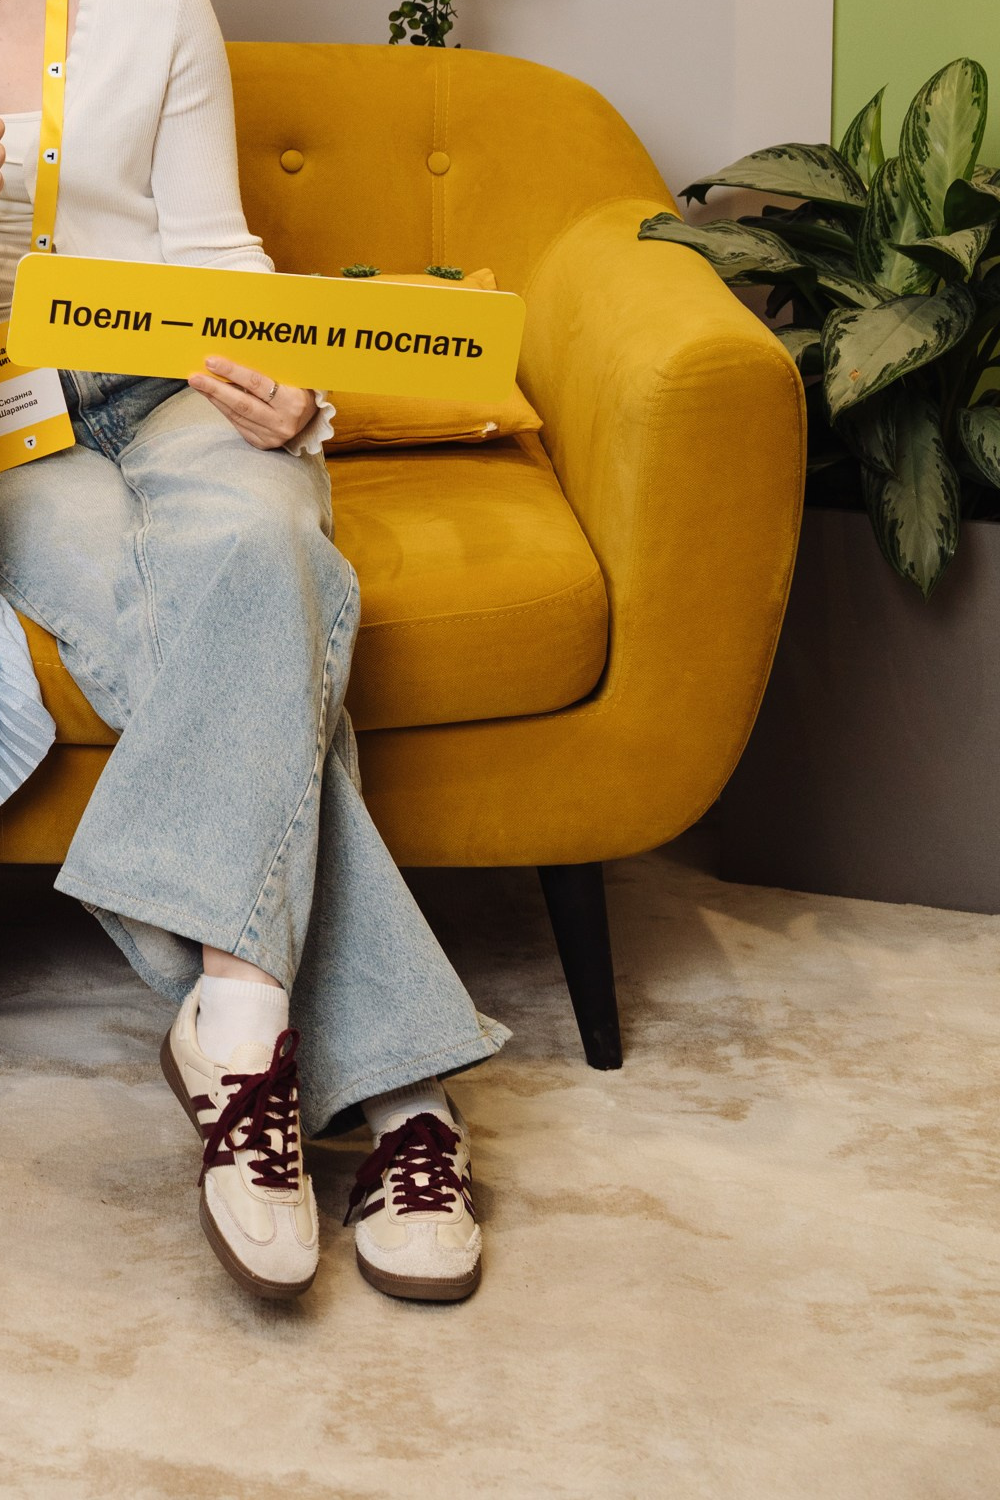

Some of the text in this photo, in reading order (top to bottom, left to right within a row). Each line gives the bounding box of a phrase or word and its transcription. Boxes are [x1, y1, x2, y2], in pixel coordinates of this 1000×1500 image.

[49, 299, 152, 332] Поели
[202, 316, 317, 346] можем
[327, 327, 345, 349] и
[355, 329, 483, 359] поспать
